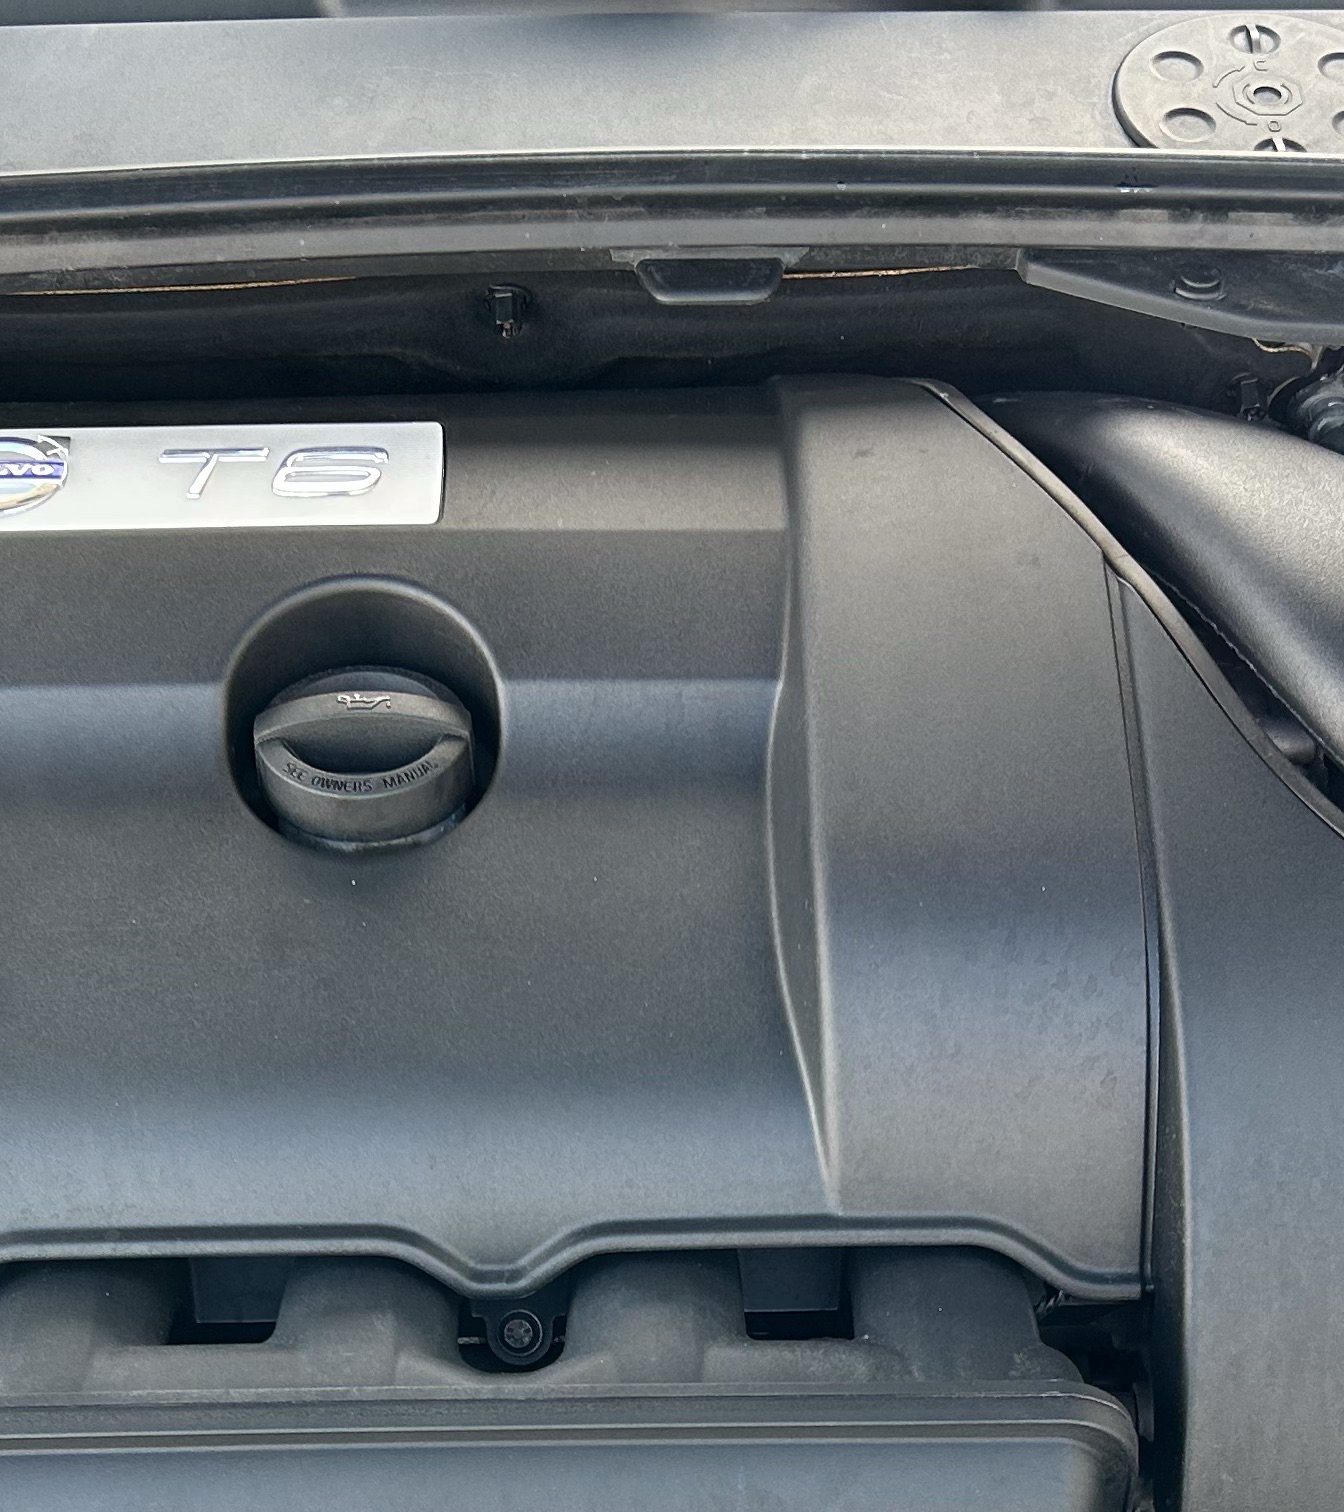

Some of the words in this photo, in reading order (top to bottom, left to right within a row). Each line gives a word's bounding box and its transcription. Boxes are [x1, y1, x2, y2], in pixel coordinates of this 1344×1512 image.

[158, 446, 390, 499] T6
[282, 762, 308, 781] SEE
[383, 761, 438, 788] MANUAL
